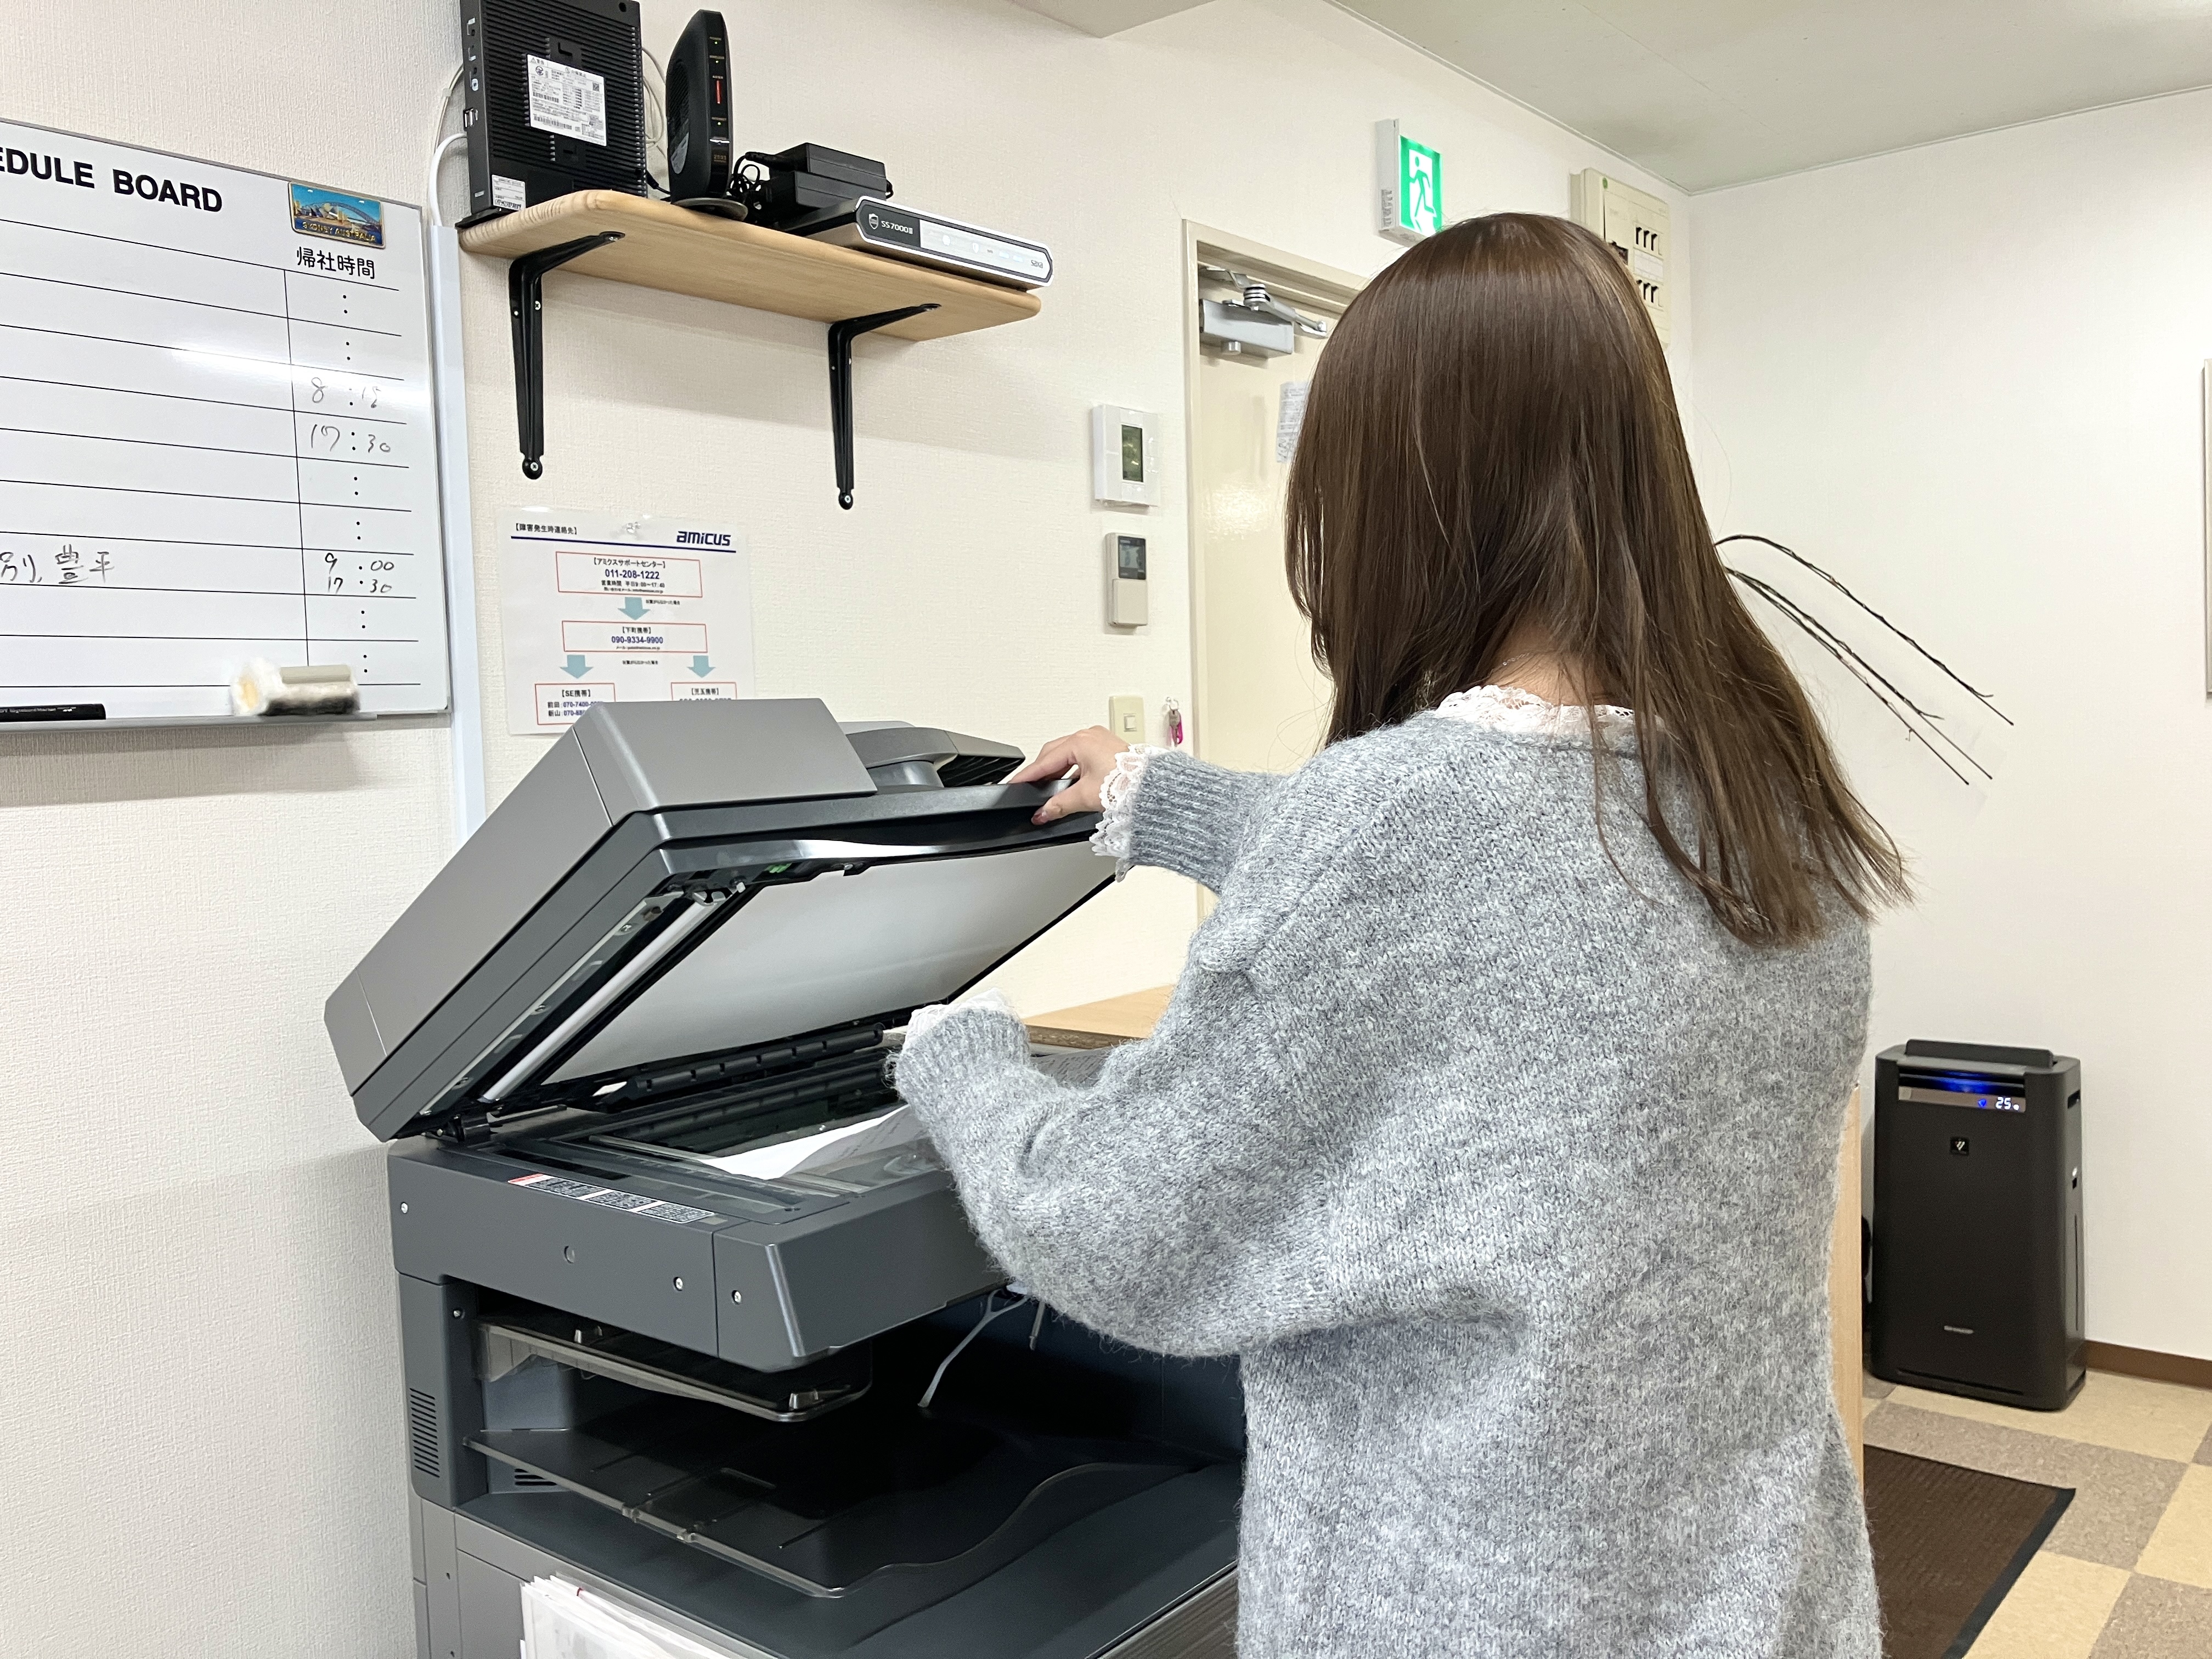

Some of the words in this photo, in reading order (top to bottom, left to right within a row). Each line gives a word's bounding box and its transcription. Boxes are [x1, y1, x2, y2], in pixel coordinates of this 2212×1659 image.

[0, 147, 95, 189] DULE
[112, 168, 222, 212] BOARD
[303, 222, 332, 234] SYDNEY
[335, 228, 376, 242] AUSTRALIA
[297, 246, 375, 279] 帰社時間
[676, 531, 731, 546] amicus
[605, 568, 660, 579] 011-208-1222
[1995, 1096, 2011, 1110] 25
